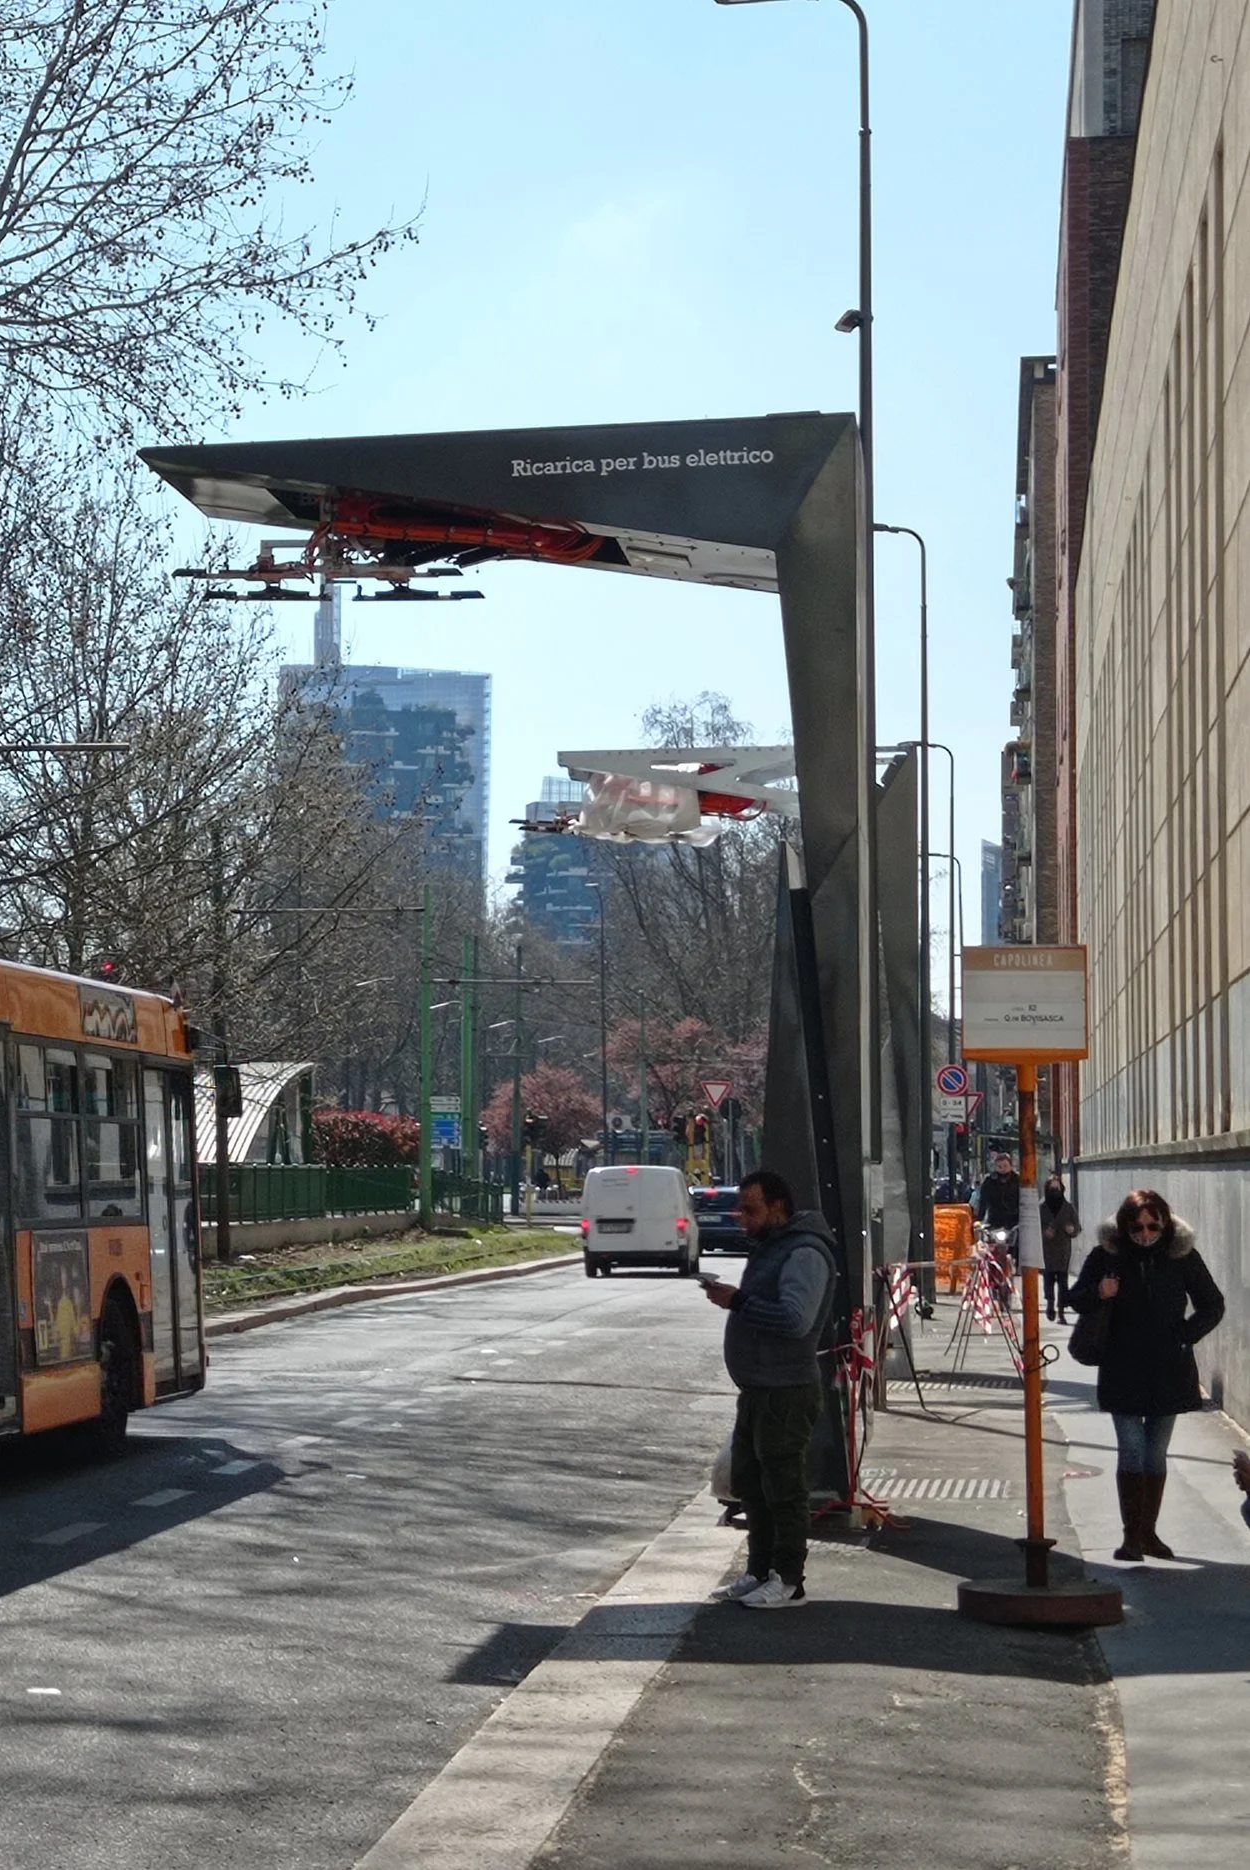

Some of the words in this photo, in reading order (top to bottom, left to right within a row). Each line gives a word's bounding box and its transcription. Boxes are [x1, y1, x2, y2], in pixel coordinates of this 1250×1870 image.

[511, 456, 596, 477] Ricarica
[600, 456, 637, 476] per
[642, 452, 681, 470] bus
[685, 447, 774, 467] elettrico
